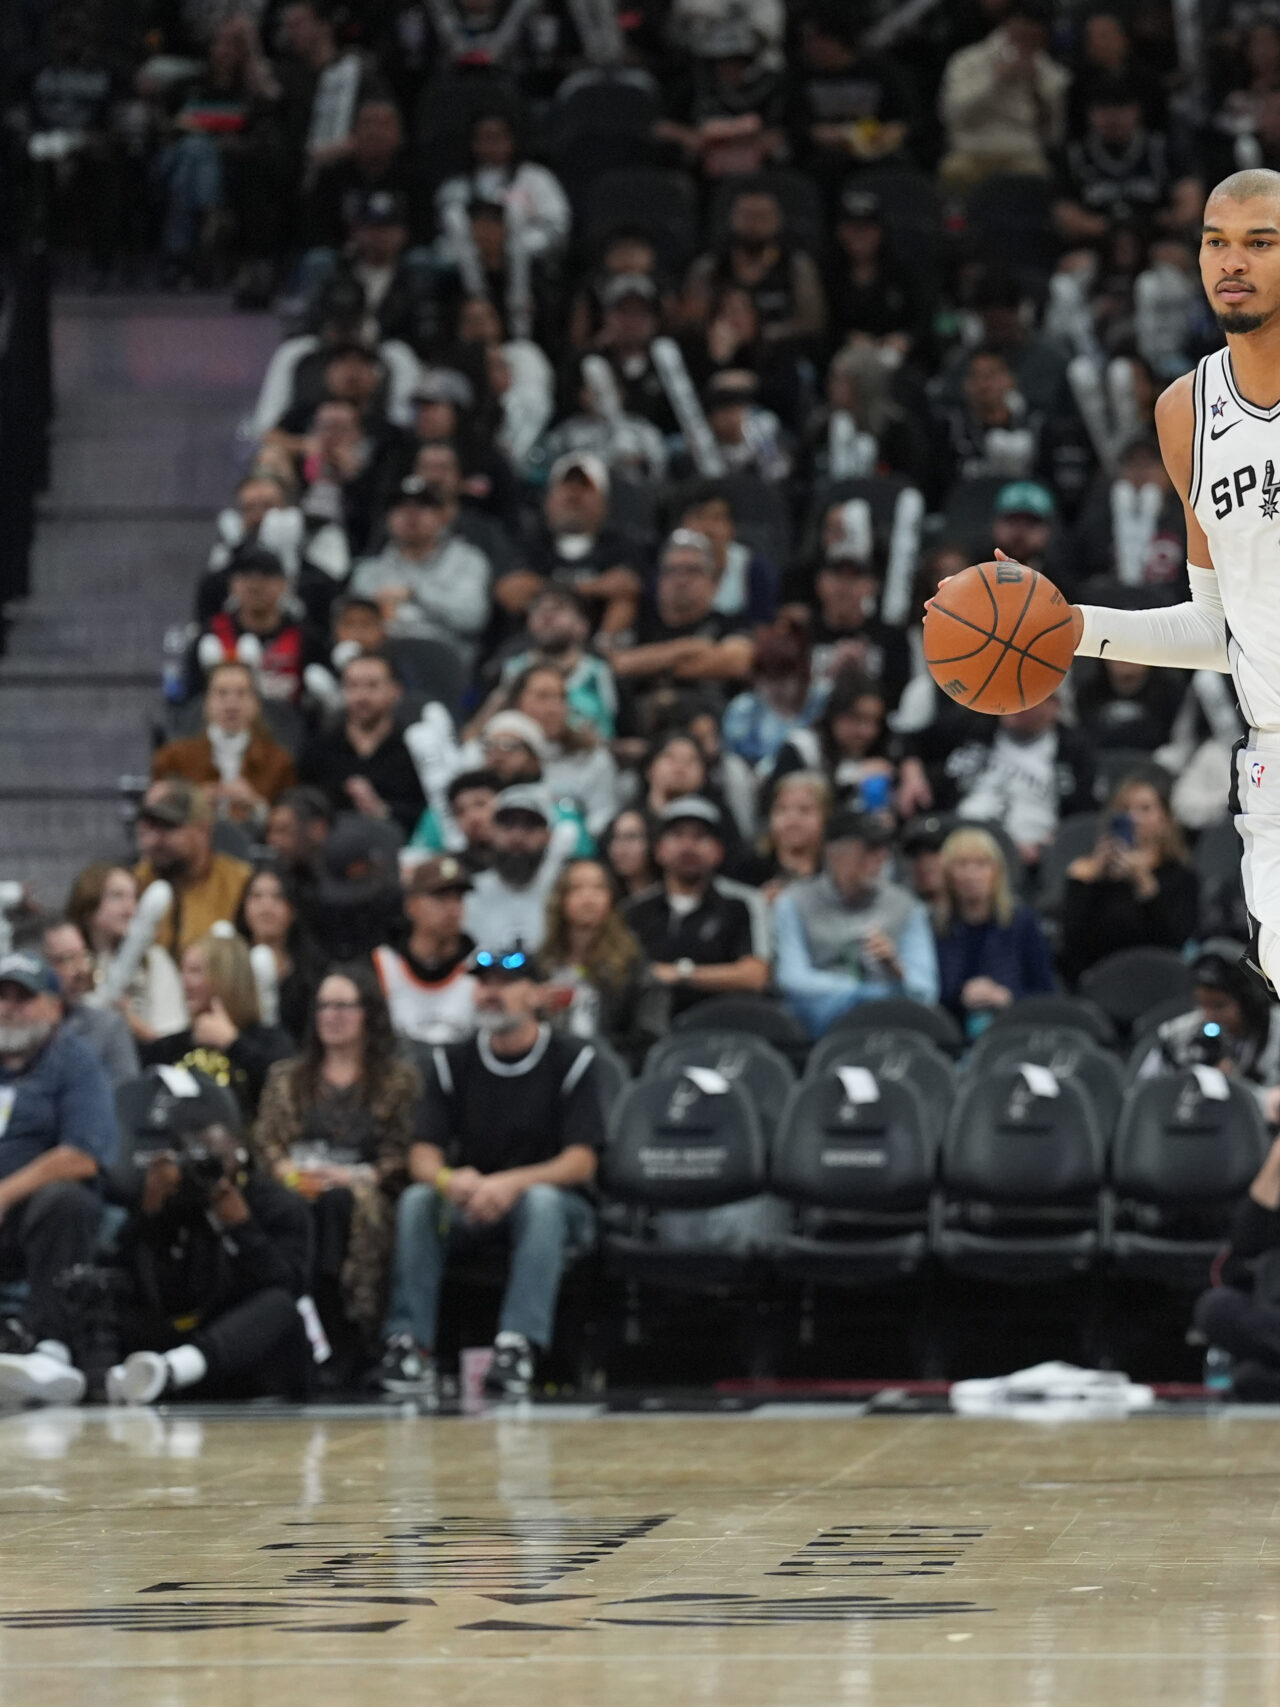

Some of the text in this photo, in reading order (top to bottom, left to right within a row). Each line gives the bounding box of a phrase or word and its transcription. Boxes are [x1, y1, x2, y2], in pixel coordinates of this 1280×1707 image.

[137, 1514, 676, 1593] Frost Bank
[762, 1524, 996, 1578] CENTER
